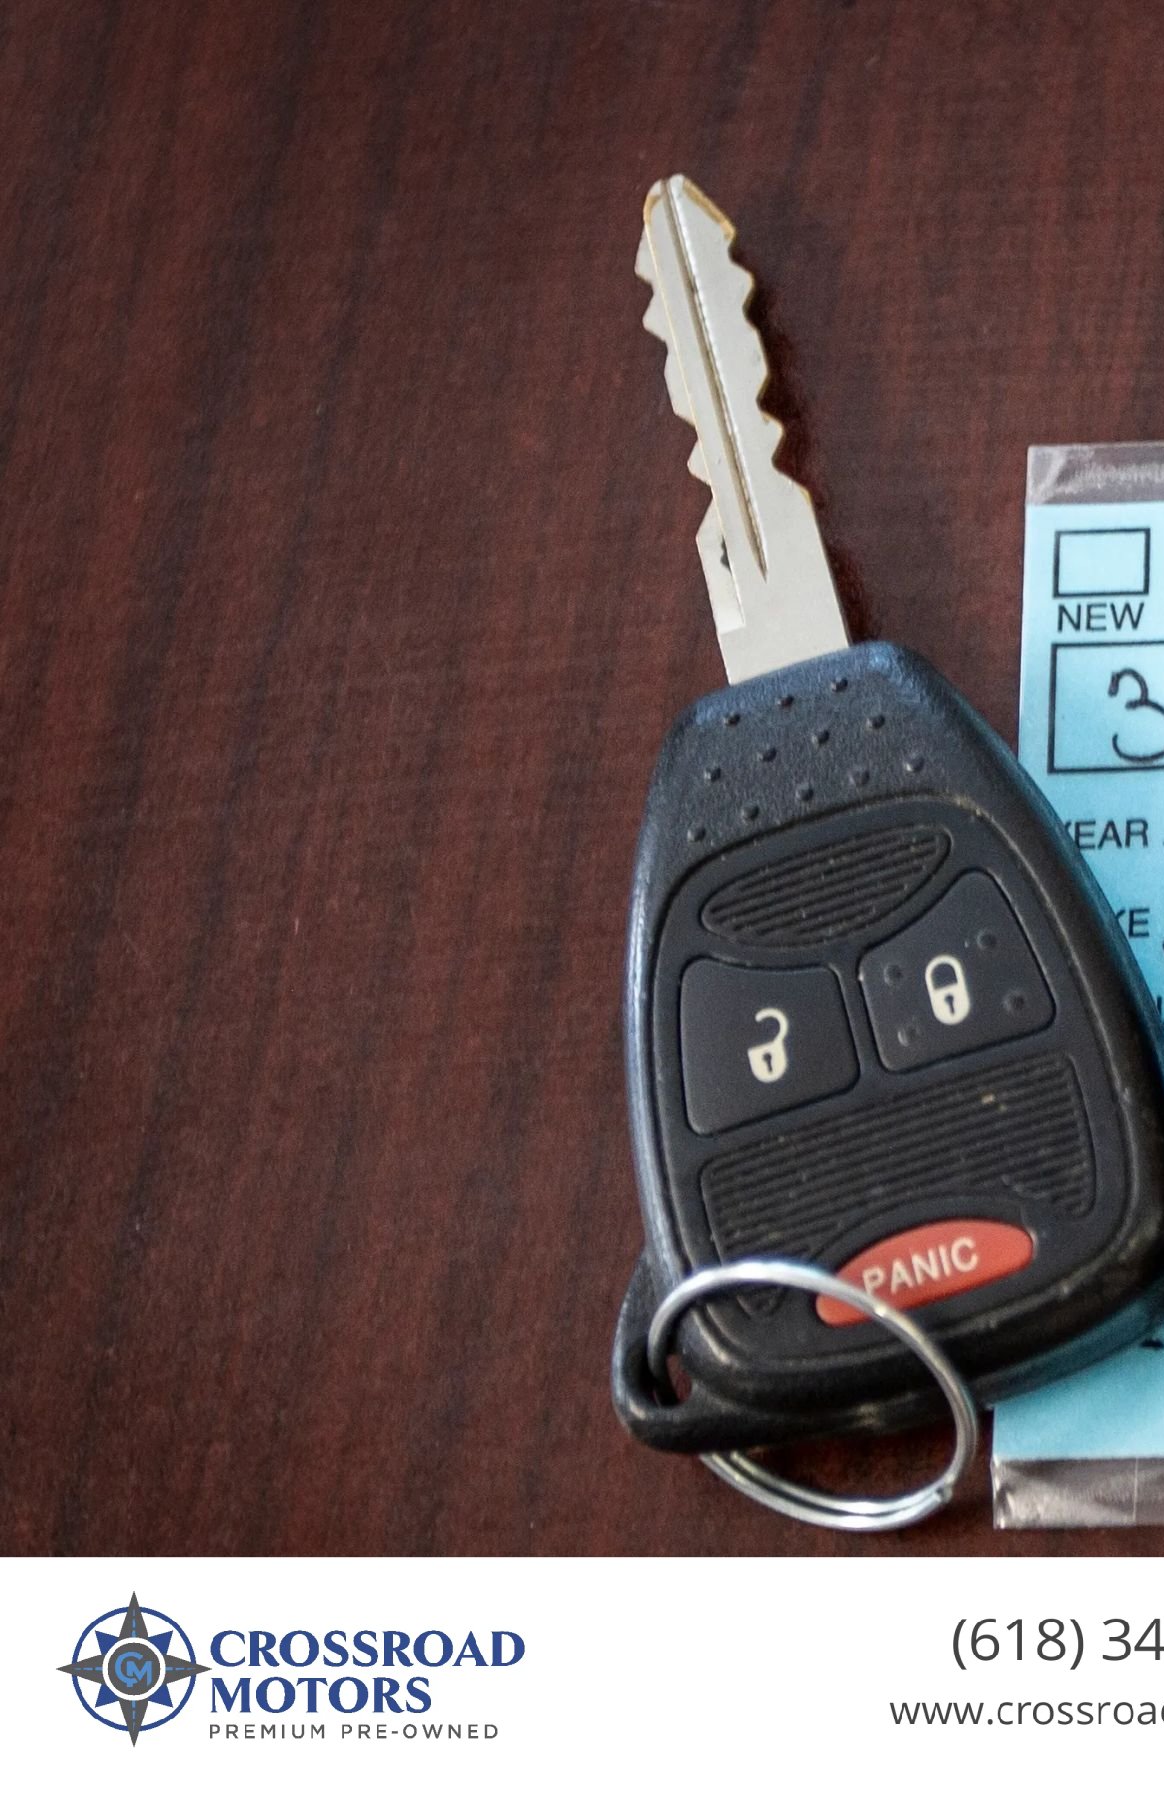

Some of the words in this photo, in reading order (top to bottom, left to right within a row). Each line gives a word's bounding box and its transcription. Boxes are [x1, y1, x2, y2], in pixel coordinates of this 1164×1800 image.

[1056, 601, 1145, 632] NEW
[1065, 818, 1150, 850] EAR
[861, 1236, 979, 1296] PANIC
